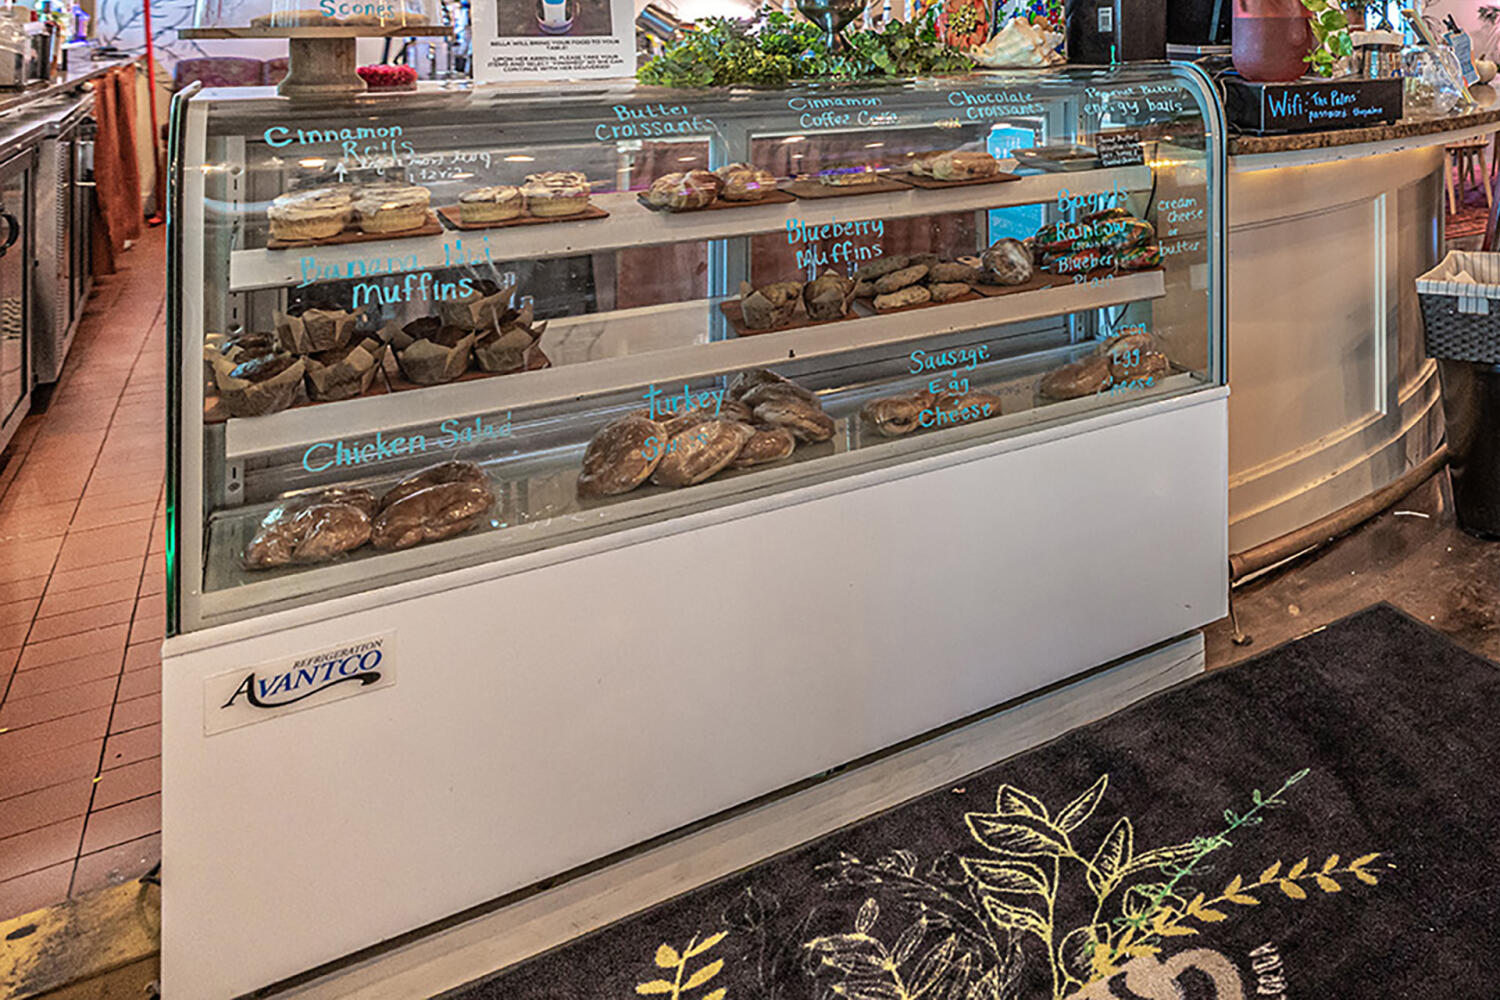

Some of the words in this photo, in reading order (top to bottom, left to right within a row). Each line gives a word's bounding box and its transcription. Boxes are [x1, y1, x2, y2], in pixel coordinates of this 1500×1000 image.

[787, 96, 883, 111] Cinnamon
[947, 90, 1035, 108] Chocolate
[263, 125, 403, 148] Cinnamon
[785, 216, 885, 245] Blueberry
[1101, 321, 1148, 338] acon
[908, 344, 992, 375] Sausage
[927, 377, 970, 396] Egg
[917, 399, 994, 429] Cheese
[302, 431, 426, 473] Chicken
[292, 638, 384, 670] REFRIGERATION
